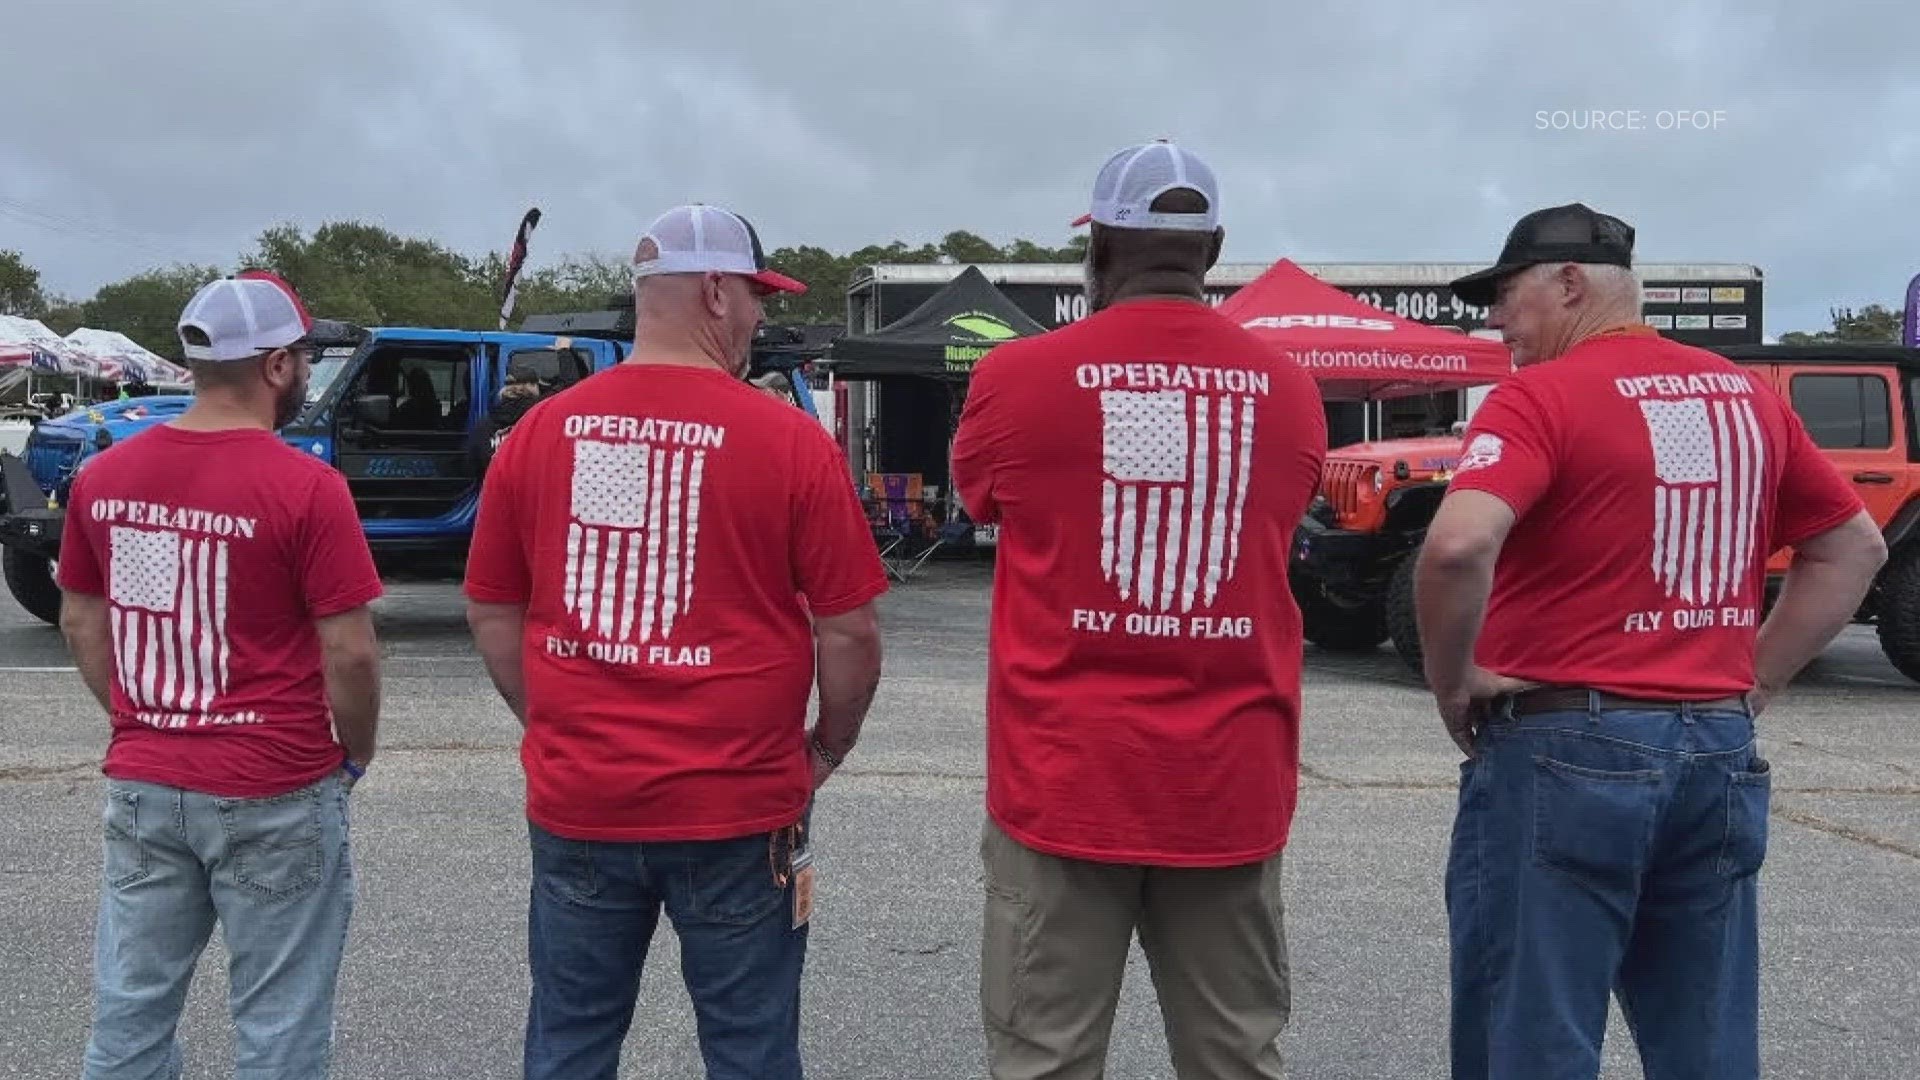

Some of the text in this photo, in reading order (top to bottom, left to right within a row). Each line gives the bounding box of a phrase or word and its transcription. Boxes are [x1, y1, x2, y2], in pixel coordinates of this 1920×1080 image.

[1240, 315, 1395, 331] ARIES
[1286, 349, 1468, 371] utomotive.com
[1073, 363, 1270, 396] OPERATION
[1615, 372, 1755, 398] OPERATION
[564, 414, 726, 449] OPERATION
[91, 498, 258, 539] OPERATION
[1072, 609, 1254, 639] FLY OUR FLAG
[1624, 610, 1663, 633] FLY
[1673, 608, 1715, 631] OUR
[546, 635, 711, 667] FLY OUR FLAG
